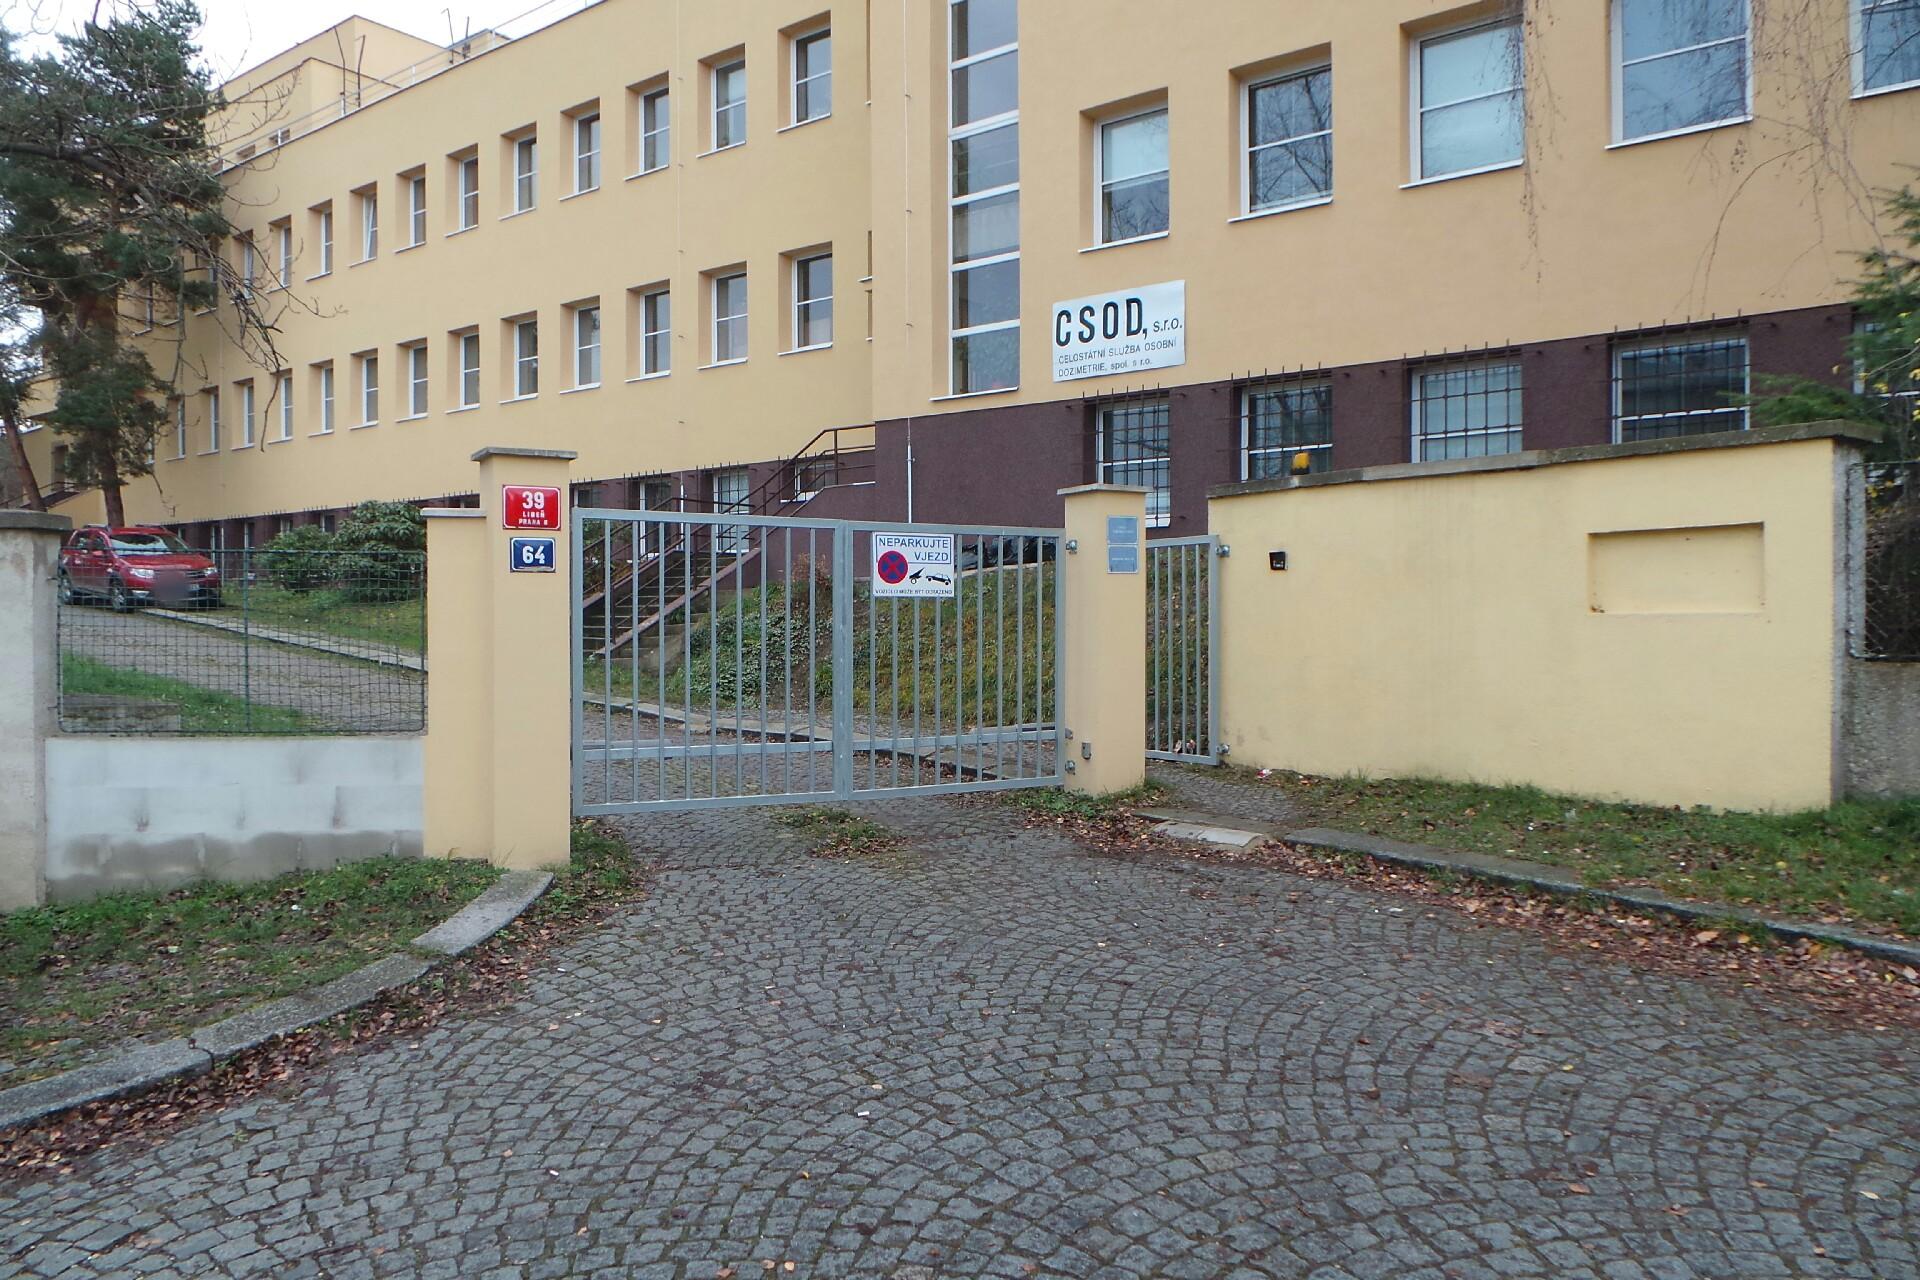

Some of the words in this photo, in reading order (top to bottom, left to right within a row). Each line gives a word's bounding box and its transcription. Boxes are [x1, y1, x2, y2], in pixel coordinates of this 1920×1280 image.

[1055, 297, 1148, 347] CSOD,
[1153, 318, 1183, 333] s.r.o.
[1108, 345, 1141, 357] SLUŽBA
[1144, 336, 1177, 352] OSOBNÍ
[522, 490, 545, 510] 39
[518, 518, 541, 526] PRAHA
[879, 537, 949, 549] NEPARKUJTE
[522, 545, 546, 565] 64
[914, 551, 949, 561] VJEZD
